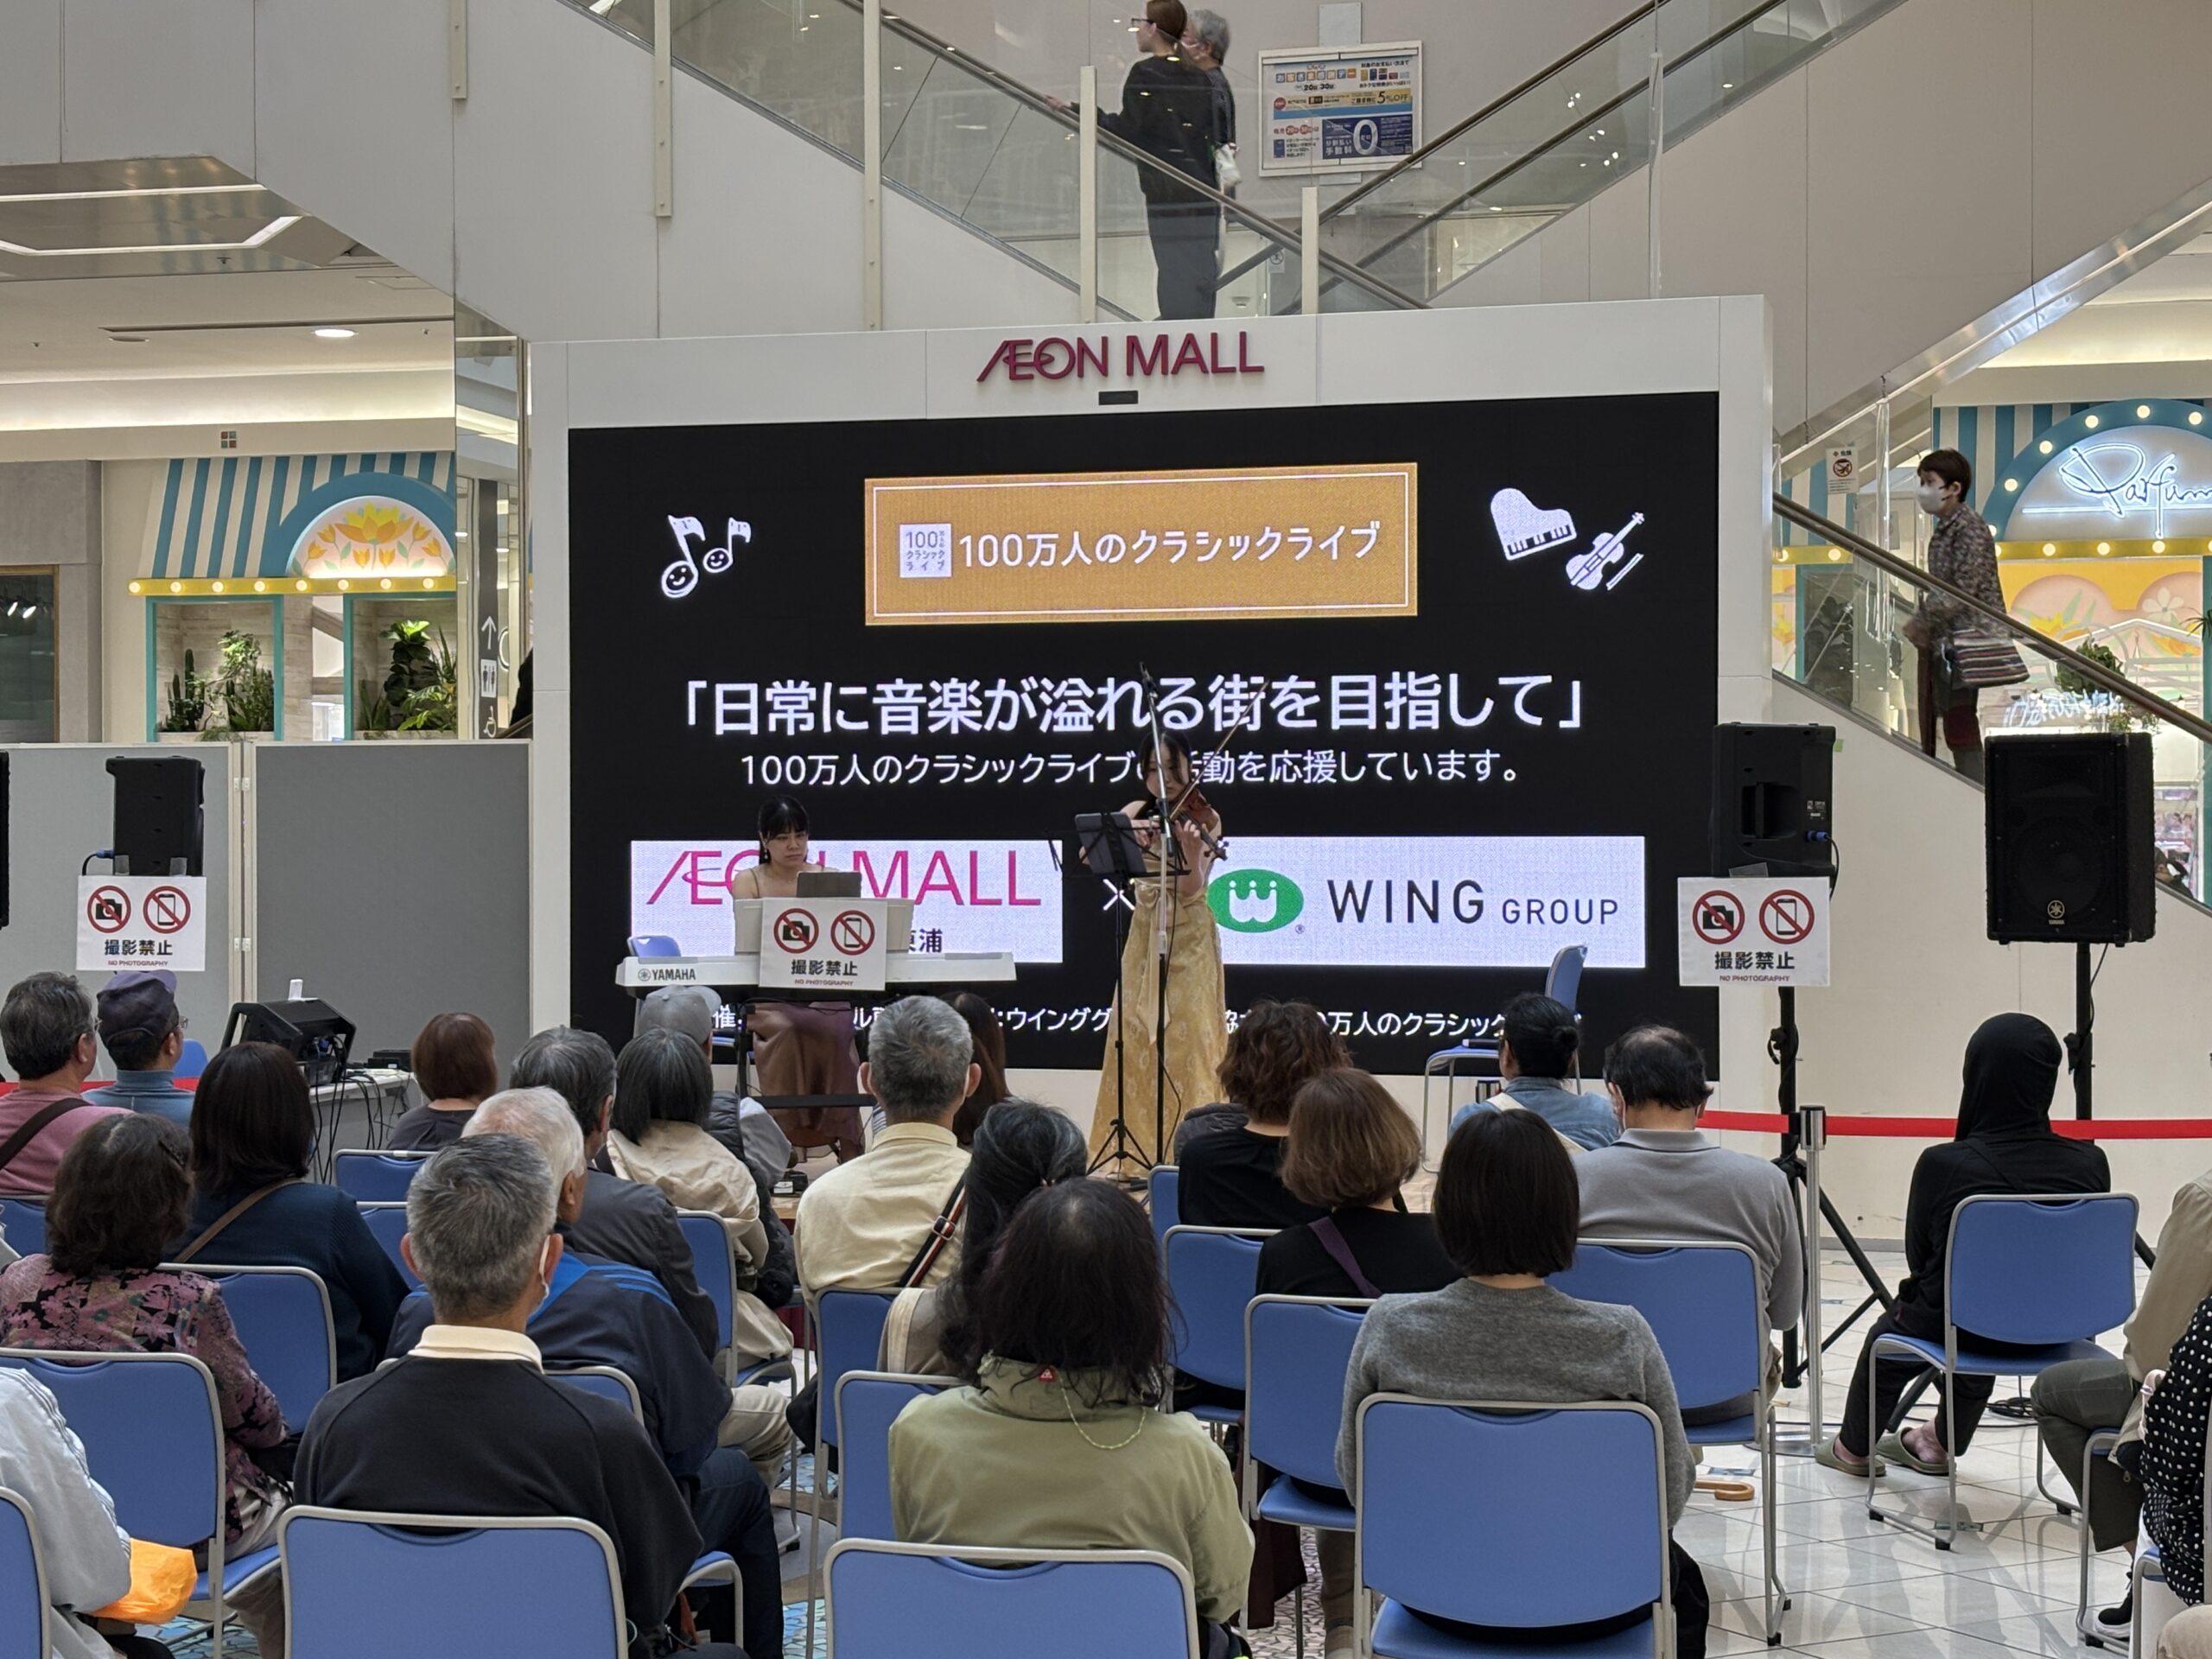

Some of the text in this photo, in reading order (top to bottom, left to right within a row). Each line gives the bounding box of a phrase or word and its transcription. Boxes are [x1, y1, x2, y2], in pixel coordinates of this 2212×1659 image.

[1126, 331, 1265, 377] MALL
[958, 520, 1381, 569] 100万人のクラシックライブ
[741, 749, 1519, 785] 100万人のクラシックライブ動を応援しています。
[1327, 879, 1619, 925] WING GROUP
[105, 938, 173, 956] 撮影禁止
[1714, 950, 1796, 969] 撮影禁止
[652, 967, 696, 982] YAMAHA
[791, 958, 858, 976] 撮影禁止
